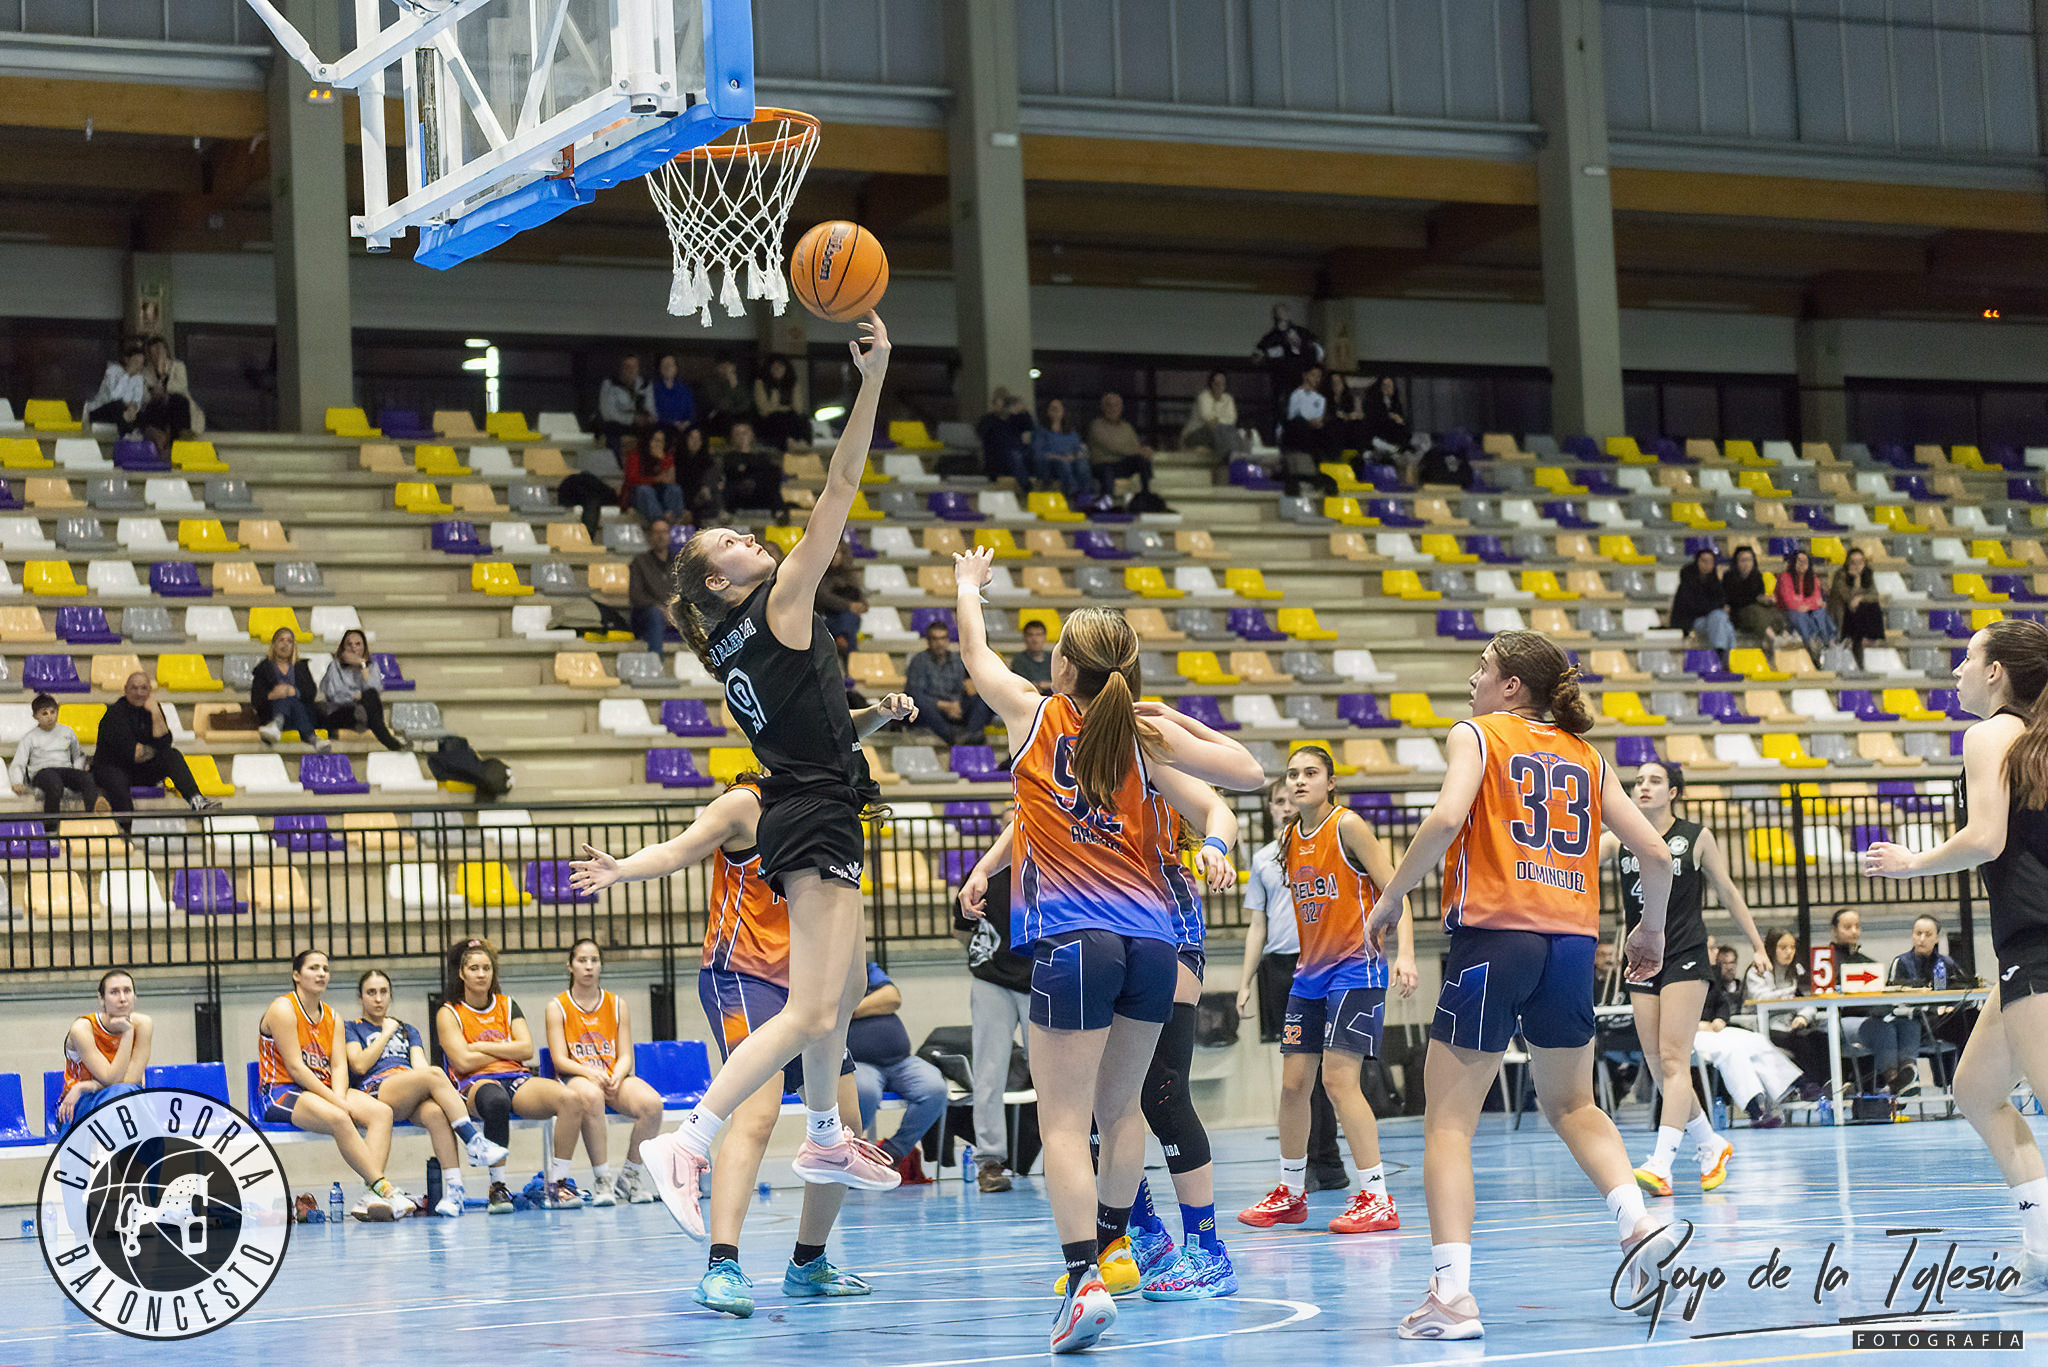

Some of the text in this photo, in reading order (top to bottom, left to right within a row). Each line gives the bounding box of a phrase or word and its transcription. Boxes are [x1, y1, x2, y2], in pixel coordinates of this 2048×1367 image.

[725, 667, 768, 735] 9
[1509, 754, 1591, 858] 33
[1302, 901, 1318, 924] 32
[1813, 949, 1833, 987] 5
[1282, 1024, 1302, 1045] 32
[816, 1117, 835, 1130] 23
